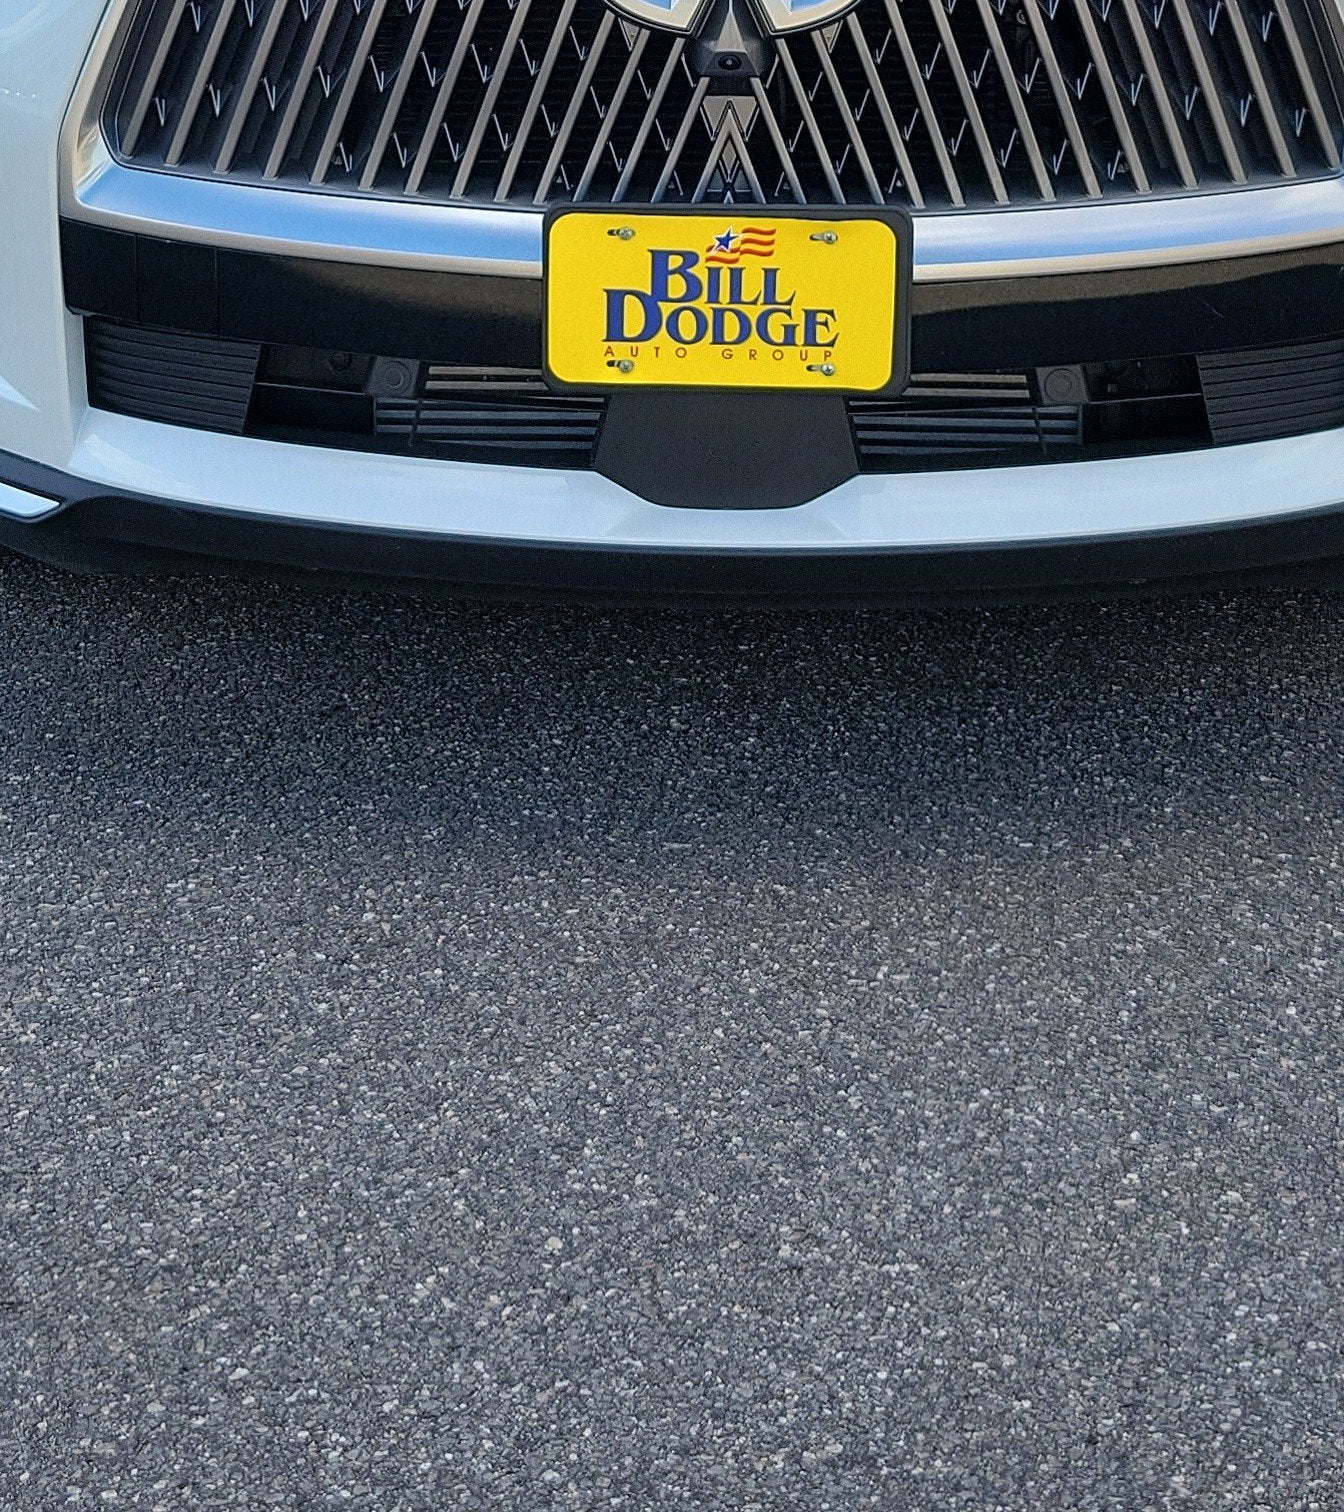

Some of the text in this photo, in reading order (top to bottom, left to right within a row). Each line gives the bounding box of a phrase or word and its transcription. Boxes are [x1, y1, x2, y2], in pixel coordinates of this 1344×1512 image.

[647, 248, 797, 307] BILL
[601, 288, 840, 348] DODGE
[604, 344, 833, 362] AUTO GROUP
